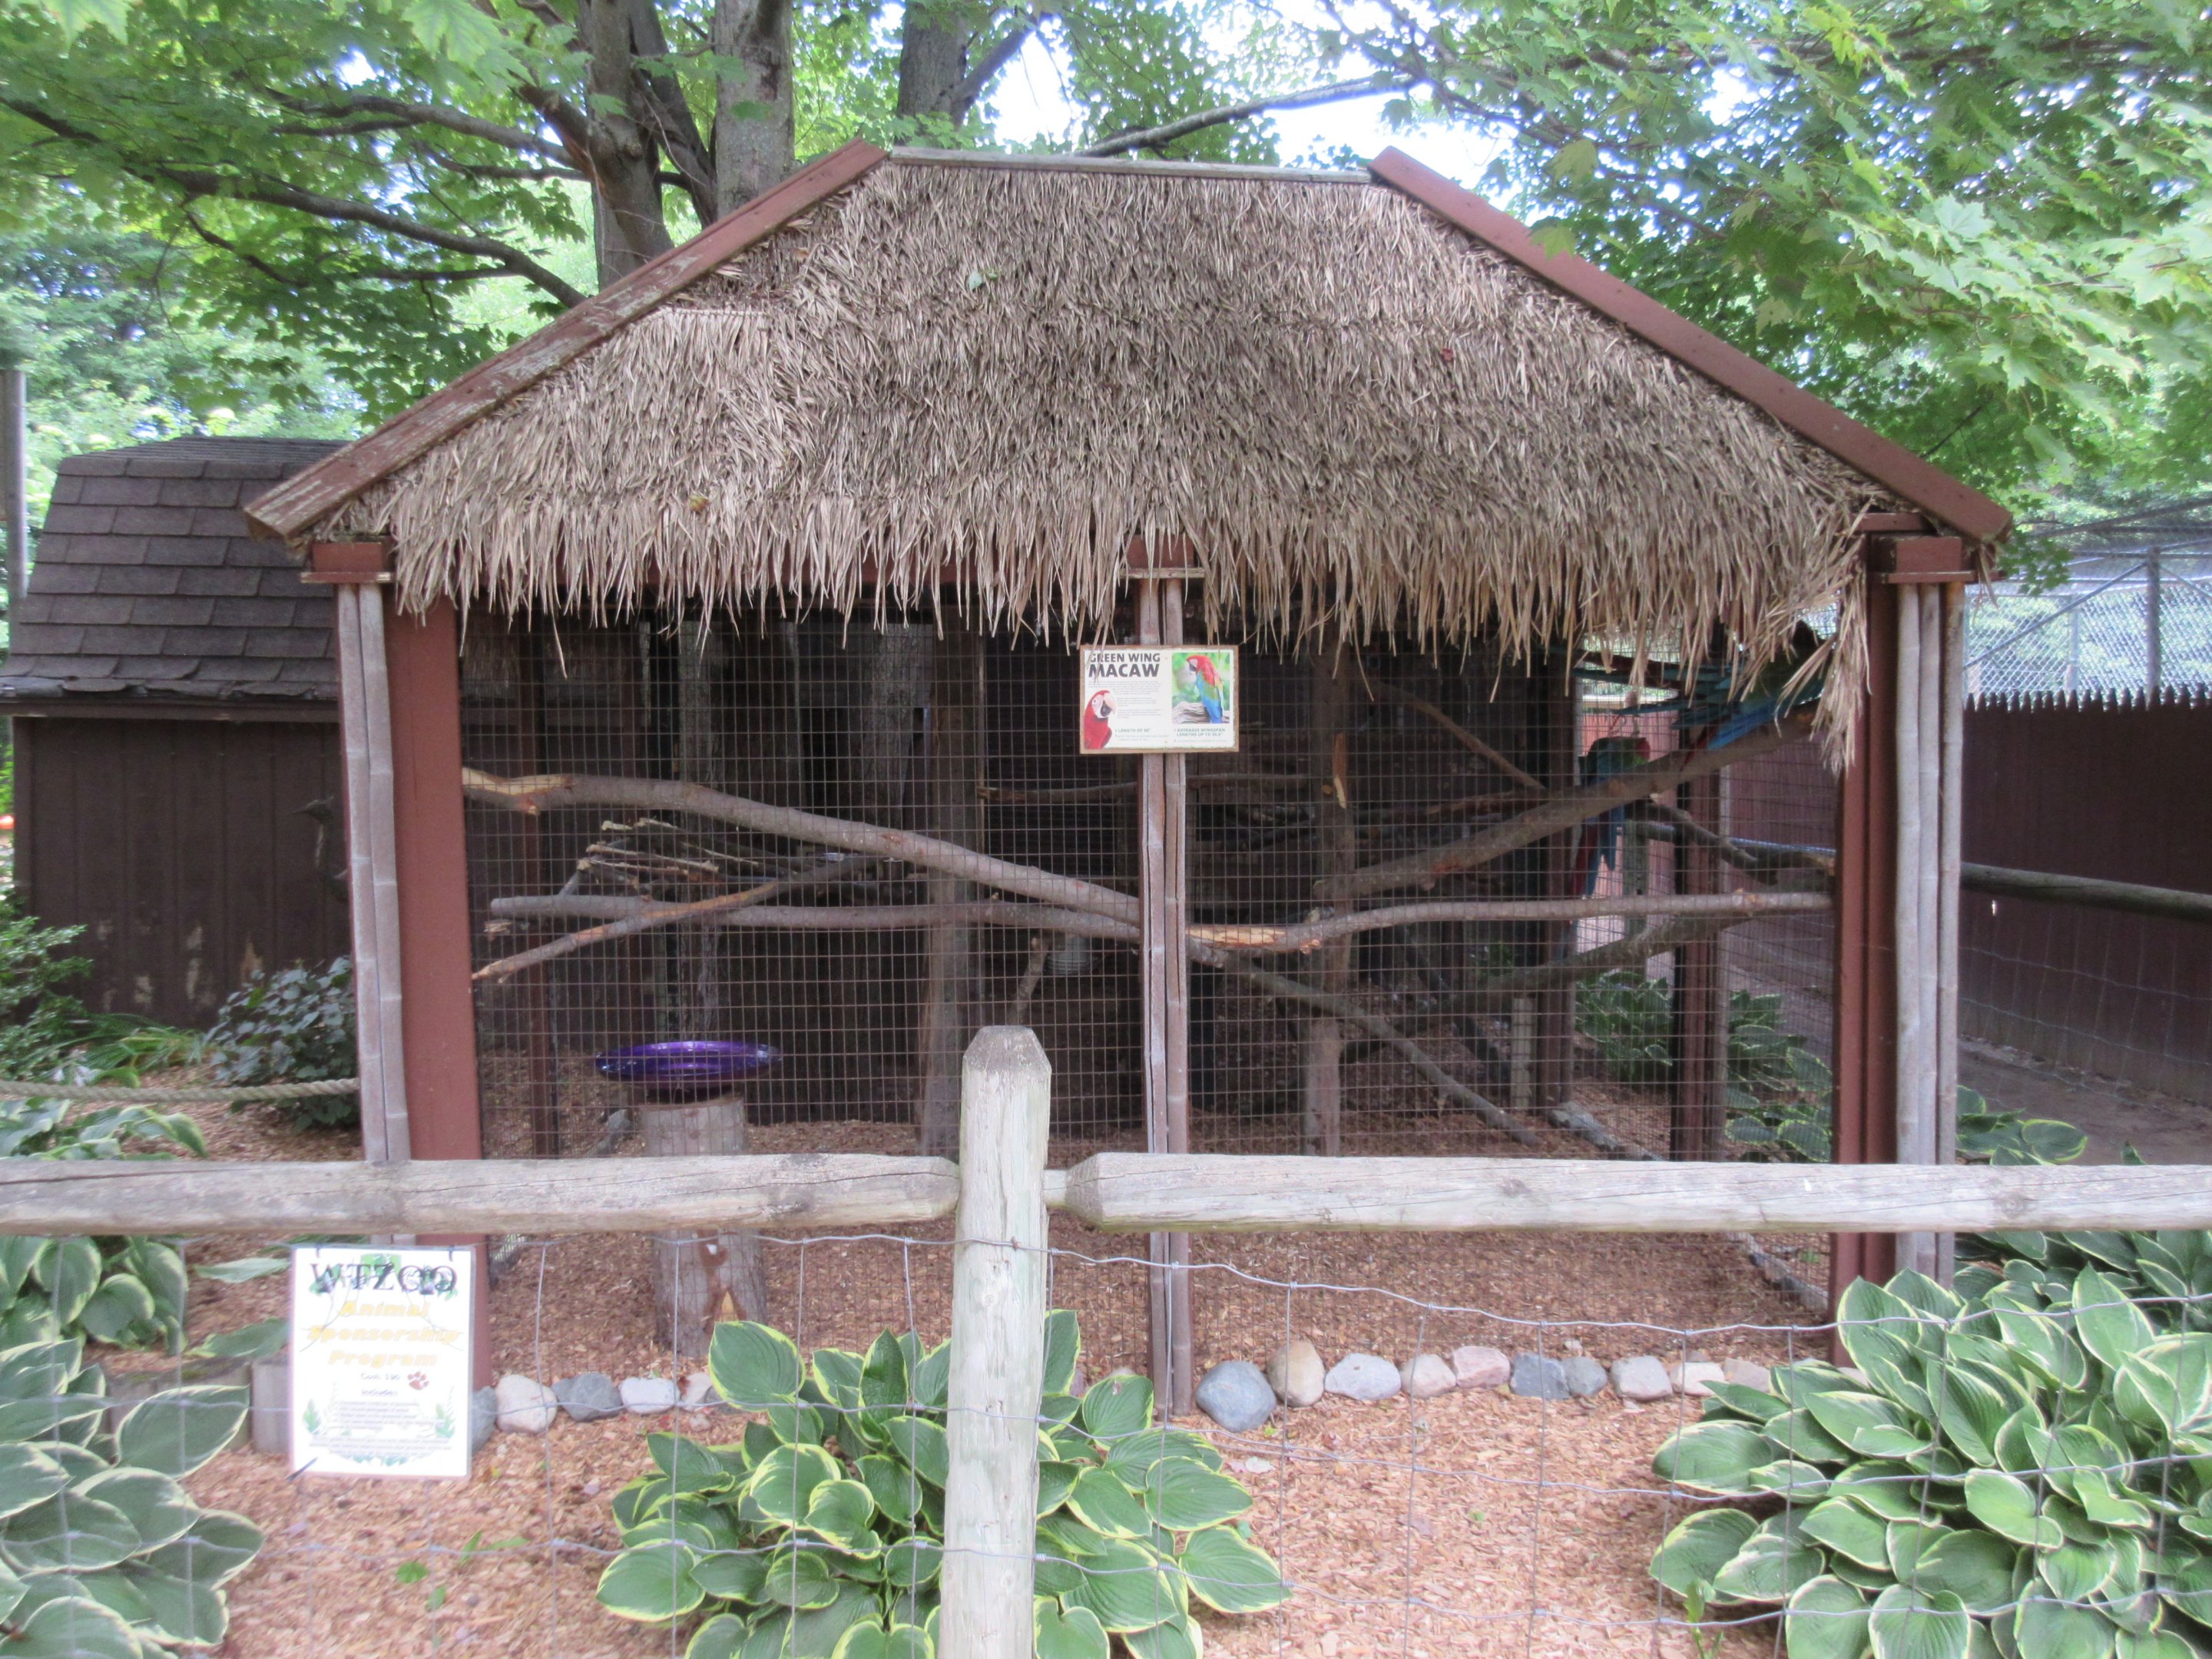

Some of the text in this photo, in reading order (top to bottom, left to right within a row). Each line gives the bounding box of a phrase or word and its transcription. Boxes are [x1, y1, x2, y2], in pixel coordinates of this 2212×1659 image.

[1089, 653, 1161, 662] GREEN WING
[1088, 664, 1160, 677] MACAW
[338, 1300, 430, 1317] Animal
[306, 1324, 460, 1345] Sponsorship
[328, 1349, 438, 1369] Program
